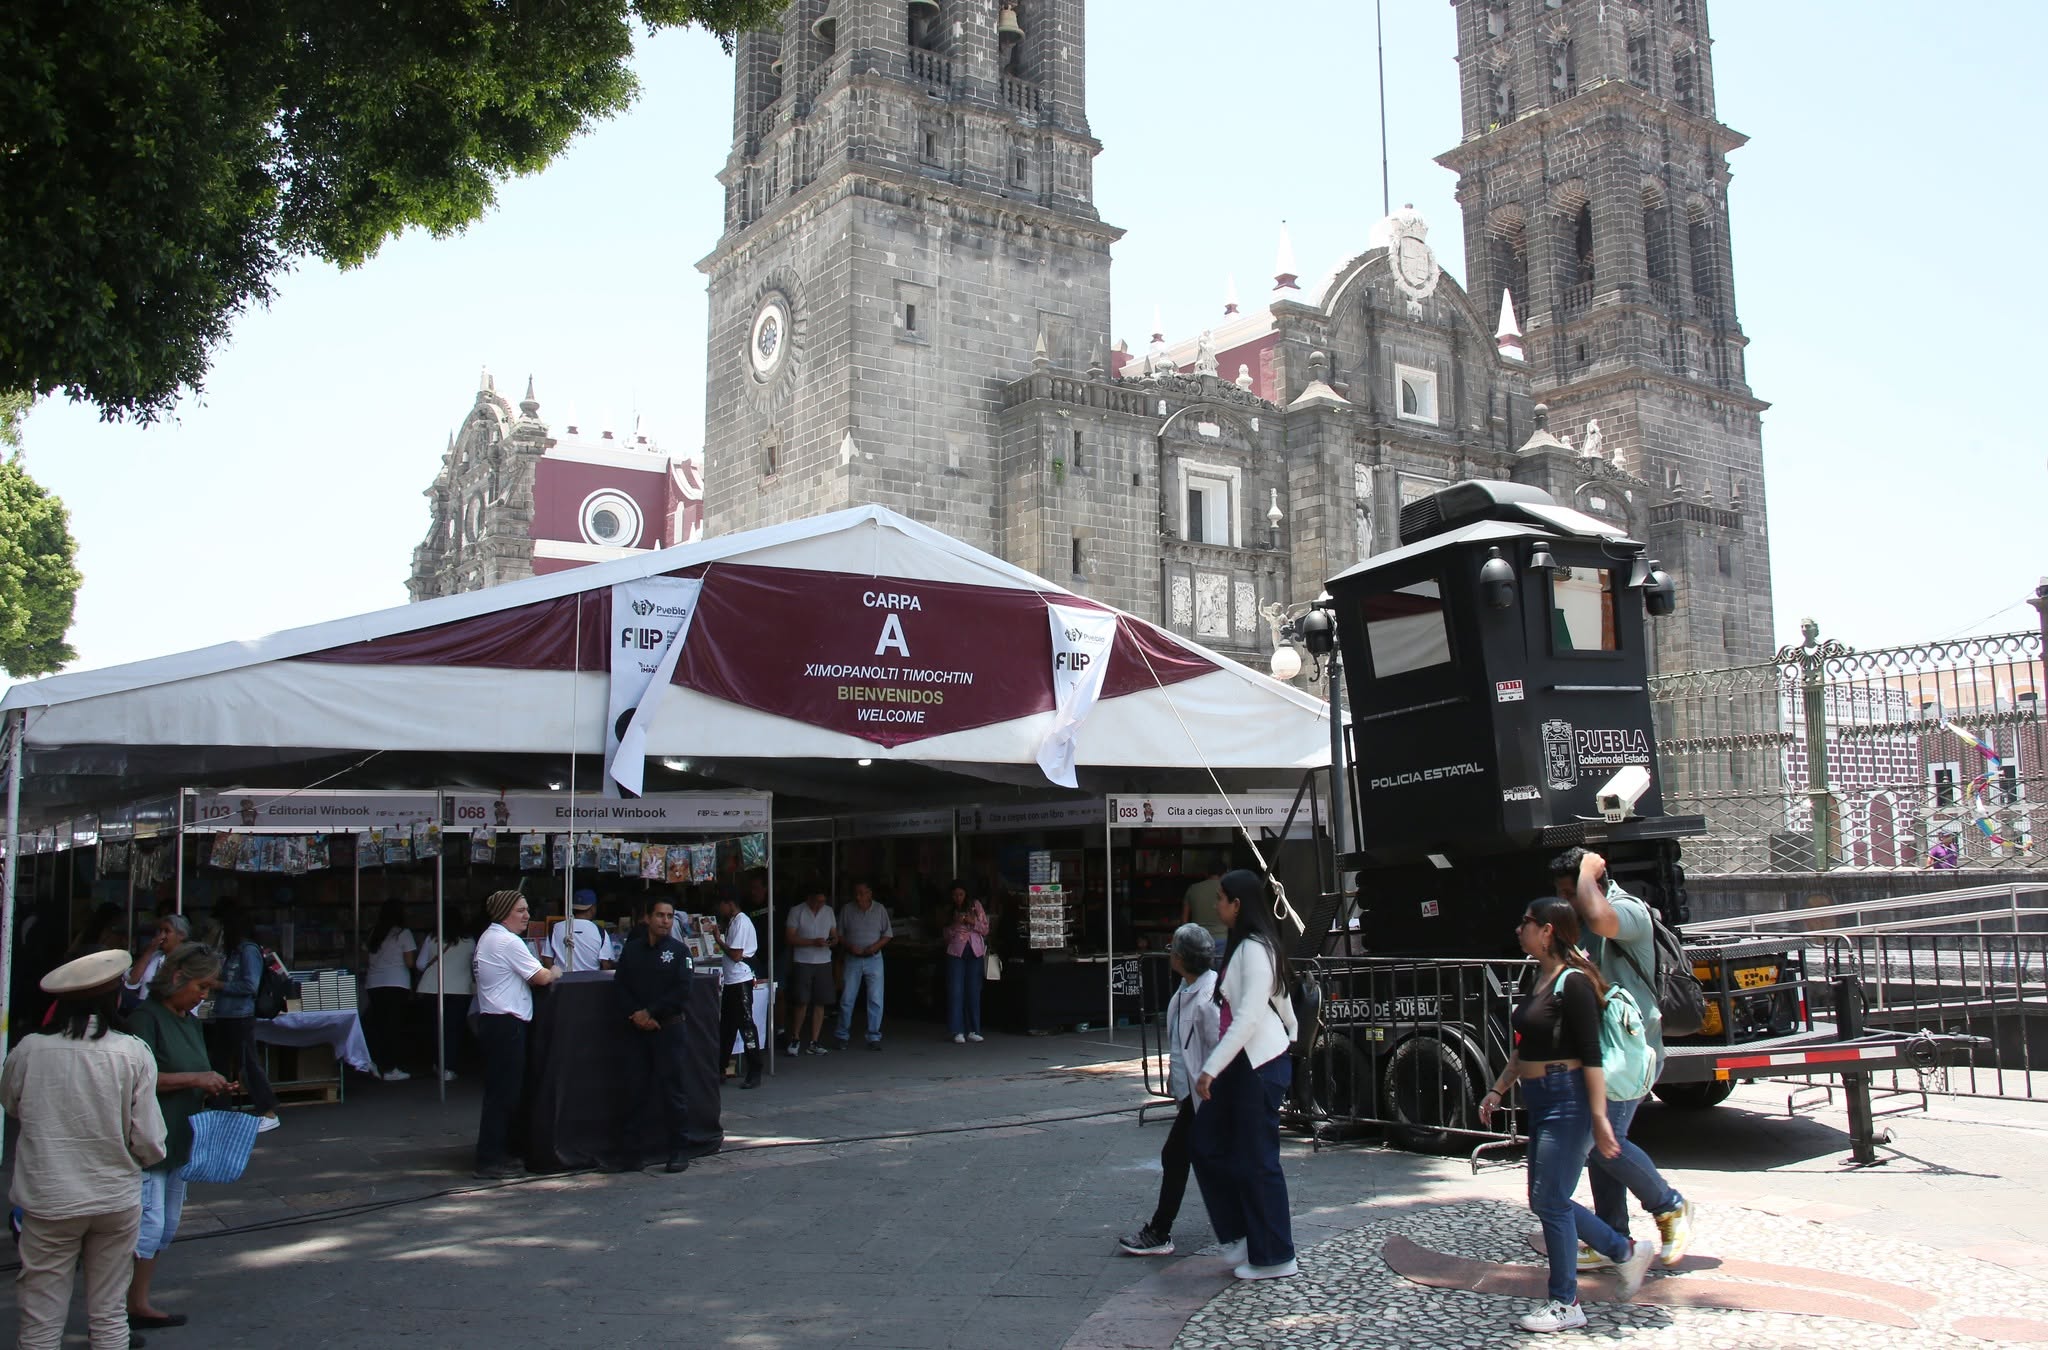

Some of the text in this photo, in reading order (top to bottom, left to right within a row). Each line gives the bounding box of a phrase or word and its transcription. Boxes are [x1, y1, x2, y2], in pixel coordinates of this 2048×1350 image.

[863, 591, 922, 612] CARPA
[621, 627, 663, 650] FILIP
[874, 613, 911, 657] A
[1056, 652, 1091, 671] FILIP
[804, 663, 974, 685] XIMOPANOLTI TIMOCHTIN
[837, 685, 944, 705] BIENVENIDOS
[857, 708, 926, 724] WELCOME
[1575, 729, 1650, 754] PUEBLA
[1578, 753, 1650, 765] Gobierno del Estado
[1371, 761, 1484, 790] POLICIA ESTATAL
[1503, 791, 1542, 802] PUEBLA
[201, 805, 230, 820] 103
[268, 805, 318, 816] Editorial
[320, 805, 370, 816] Winbook
[458, 806, 486, 819] 068
[555, 806, 609, 818] Editorial
[611, 806, 667, 818] Winbook
[1119, 807, 1138, 818] 033
[1167, 807, 1186, 816] Cita
[1195, 807, 1223, 817] ciegas
[1255, 806, 1274, 815] libro
[1325, 1003, 1370, 1019] ESTADO
[1374, 1002, 1391, 1017] DE
